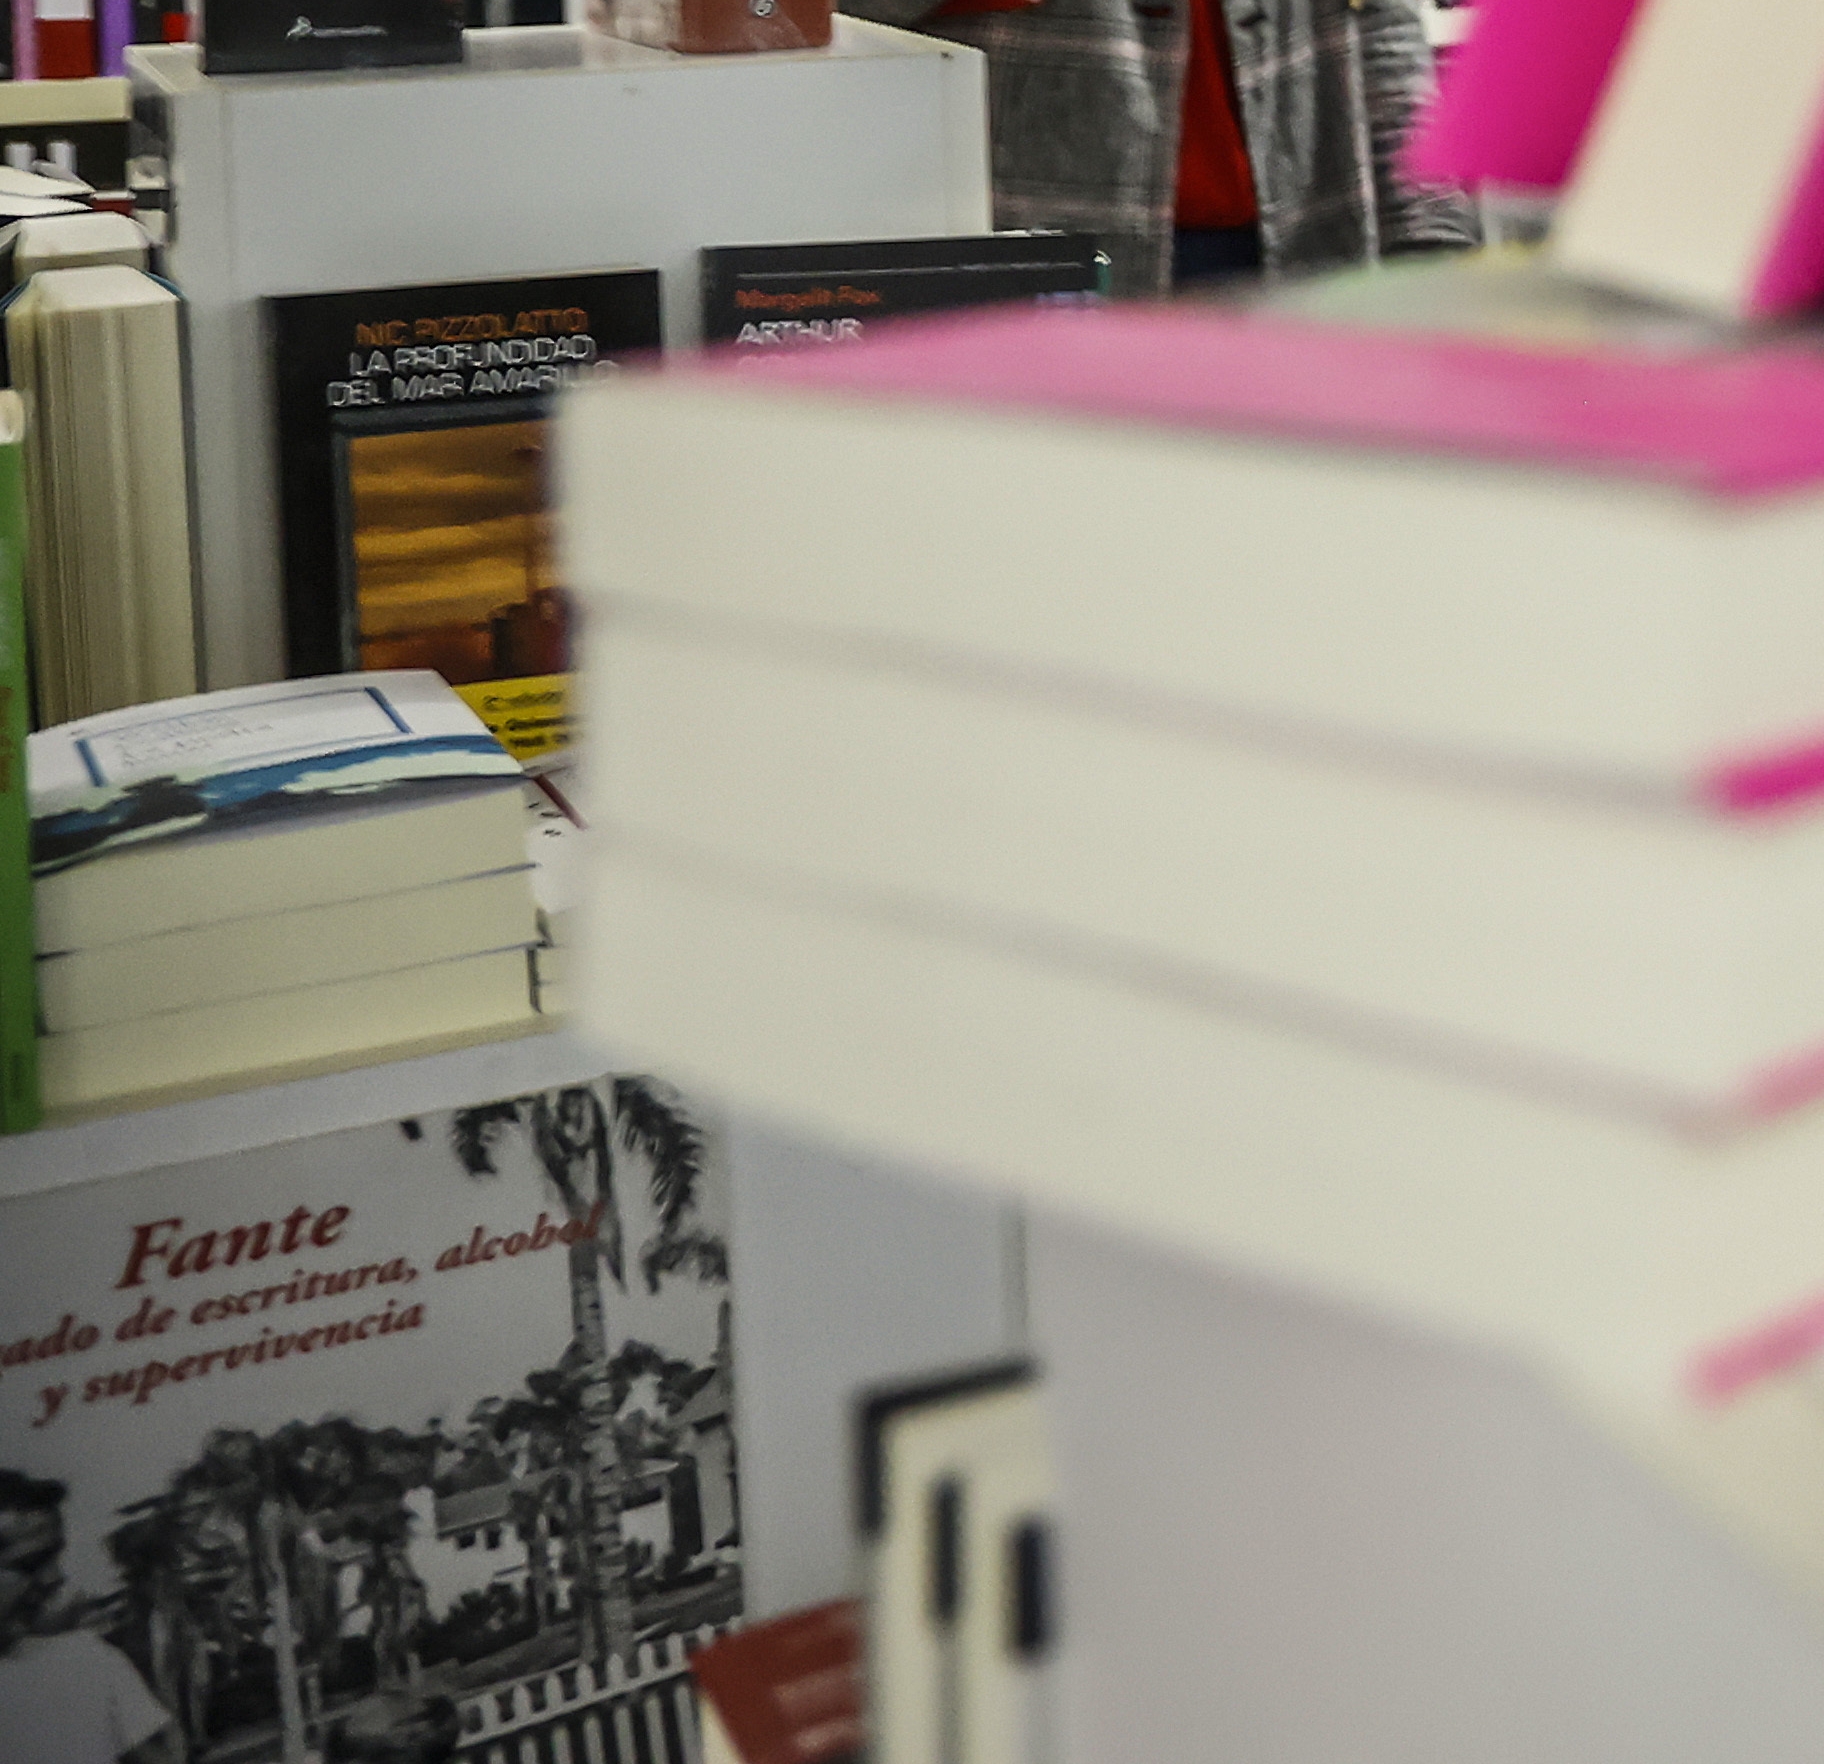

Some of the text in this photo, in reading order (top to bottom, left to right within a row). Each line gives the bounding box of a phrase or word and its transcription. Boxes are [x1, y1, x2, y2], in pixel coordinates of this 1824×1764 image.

[355, 320, 409, 347] NIC
[735, 316, 864, 346] ARTHUR
[349, 334, 600, 378] LA PROFUNDIDAD
[325, 379, 387, 407] DEL
[391, 372, 464, 402] MAR
[114, 1203, 351, 1290] Fante
[0, 1314, 101, 1380] ado
[115, 1297, 177, 1343] de
[189, 1254, 418, 1326] escritura,
[31, 1300, 426, 1428] y supervivencia
